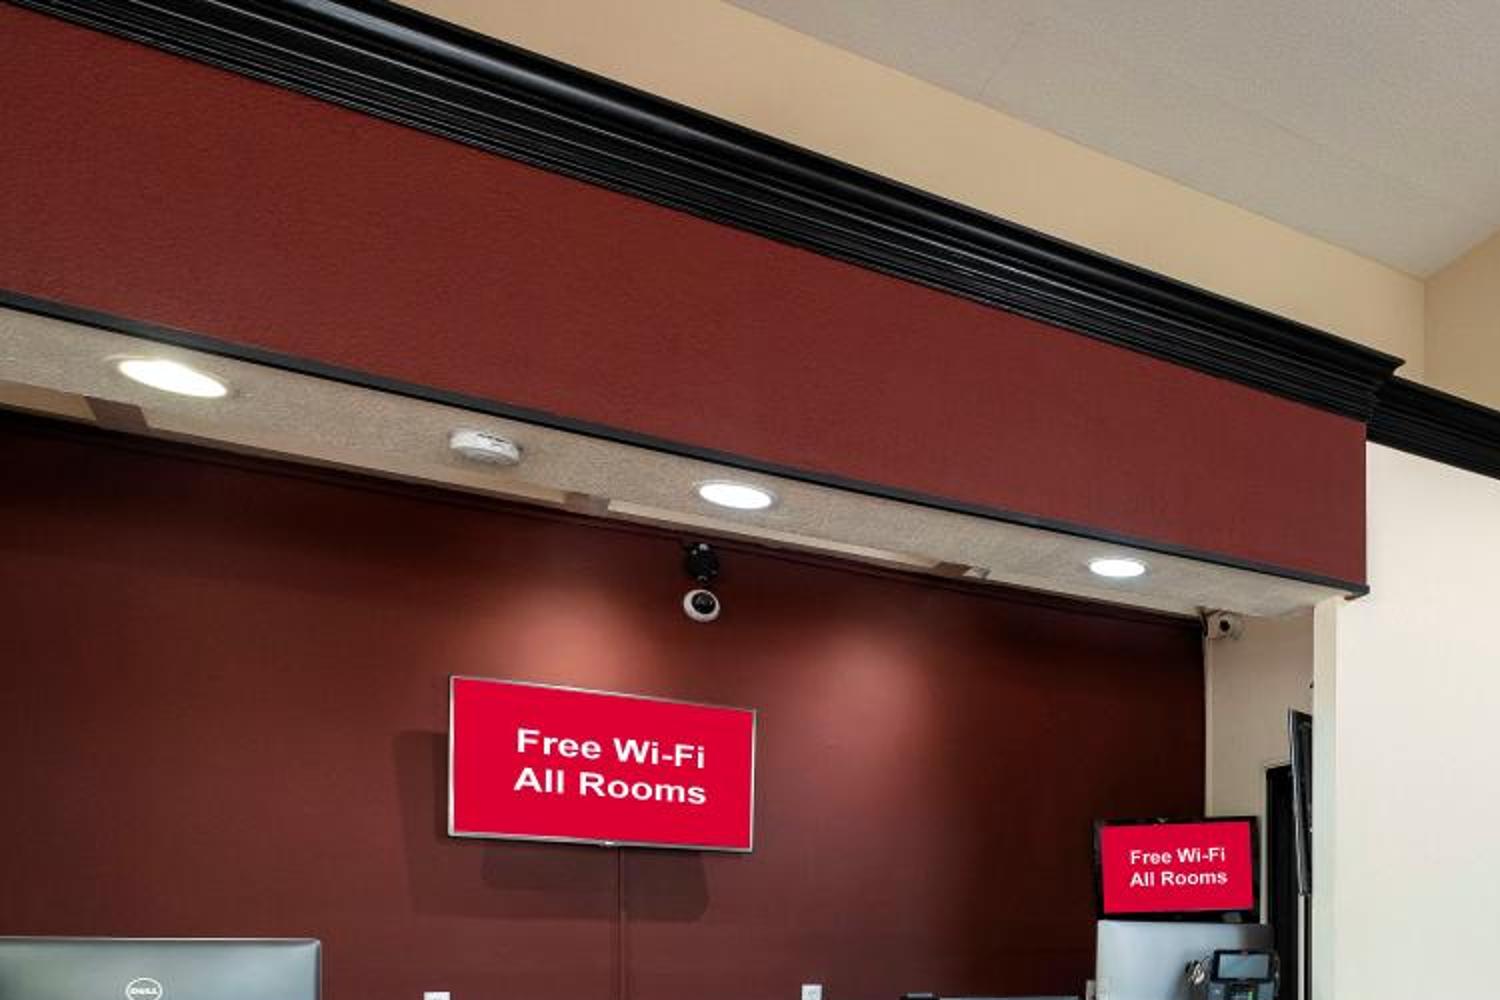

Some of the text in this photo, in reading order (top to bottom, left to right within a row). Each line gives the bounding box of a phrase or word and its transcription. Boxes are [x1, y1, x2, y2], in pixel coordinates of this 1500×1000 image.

[516, 726, 706, 770] Free Wi-Fi
[512, 766, 708, 806] All Rooms
[1129, 846, 1226, 866] Free Wi-Fi
[1129, 870, 1229, 888] All Rooms
[130, 986, 159, 996] DELL
